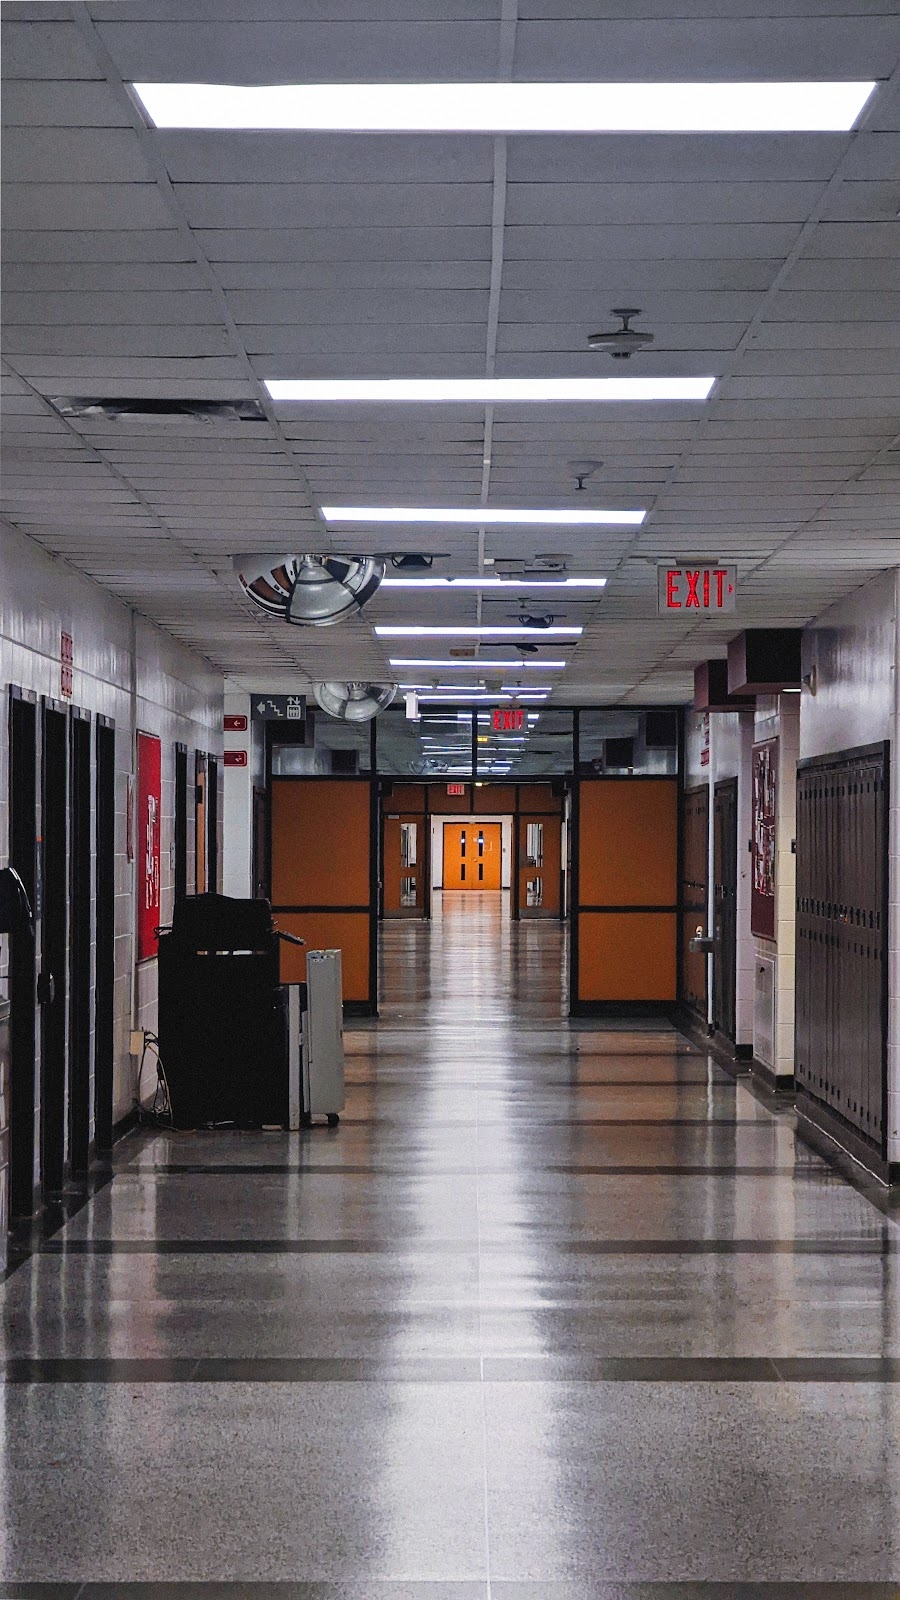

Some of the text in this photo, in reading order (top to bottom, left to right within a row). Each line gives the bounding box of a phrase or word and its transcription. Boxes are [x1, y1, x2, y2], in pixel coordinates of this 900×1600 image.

[666, 570, 728, 608] EXIT
[493, 710, 525, 731] EXIT
[448, 785, 463, 794] EXIT
